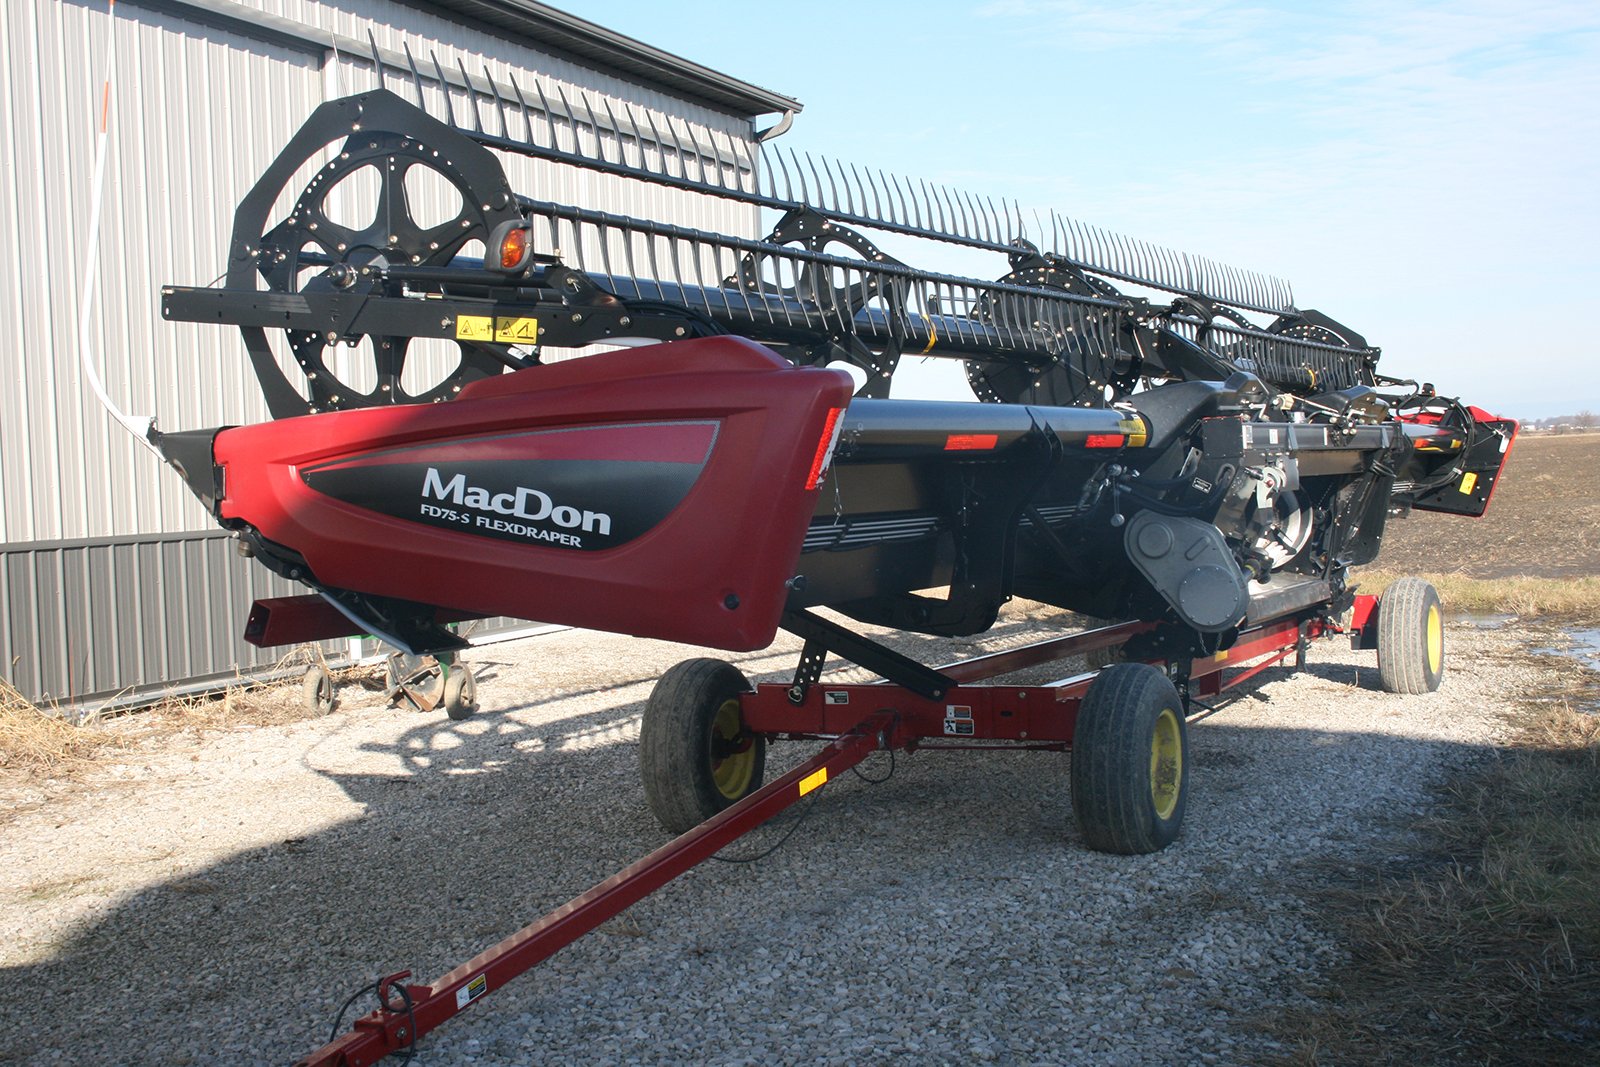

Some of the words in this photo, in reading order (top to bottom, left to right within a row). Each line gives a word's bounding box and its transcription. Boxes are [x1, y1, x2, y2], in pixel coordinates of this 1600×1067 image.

[420, 504, 470, 524] FD75-S
[476, 516, 582, 548] FLEXDRAPER
[421, 467, 611, 536] MacDon
